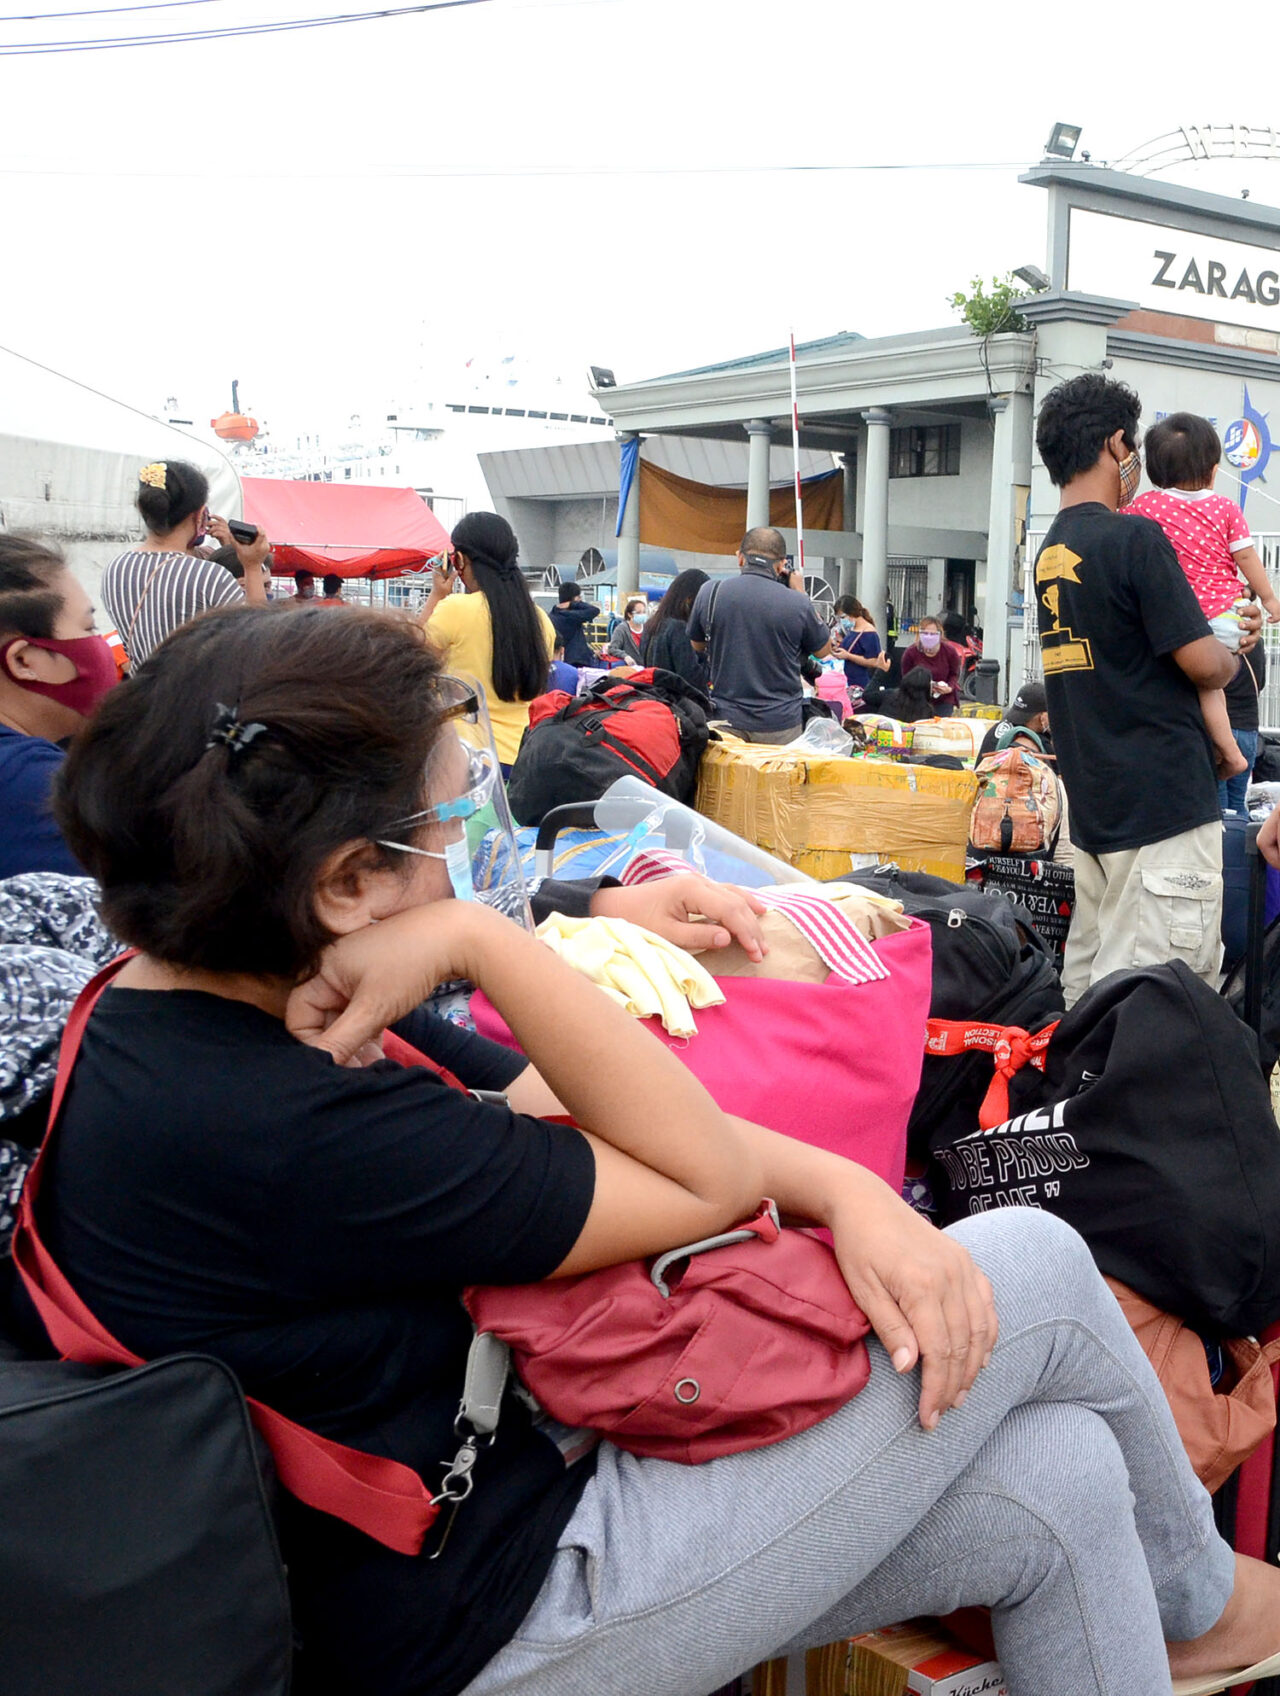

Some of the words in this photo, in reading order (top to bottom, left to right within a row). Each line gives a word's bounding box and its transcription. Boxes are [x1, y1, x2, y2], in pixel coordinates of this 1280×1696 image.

[934, 1146, 967, 1190] TO
[956, 1141, 994, 1188] BE
[990, 1132, 1090, 1183] PROUD
